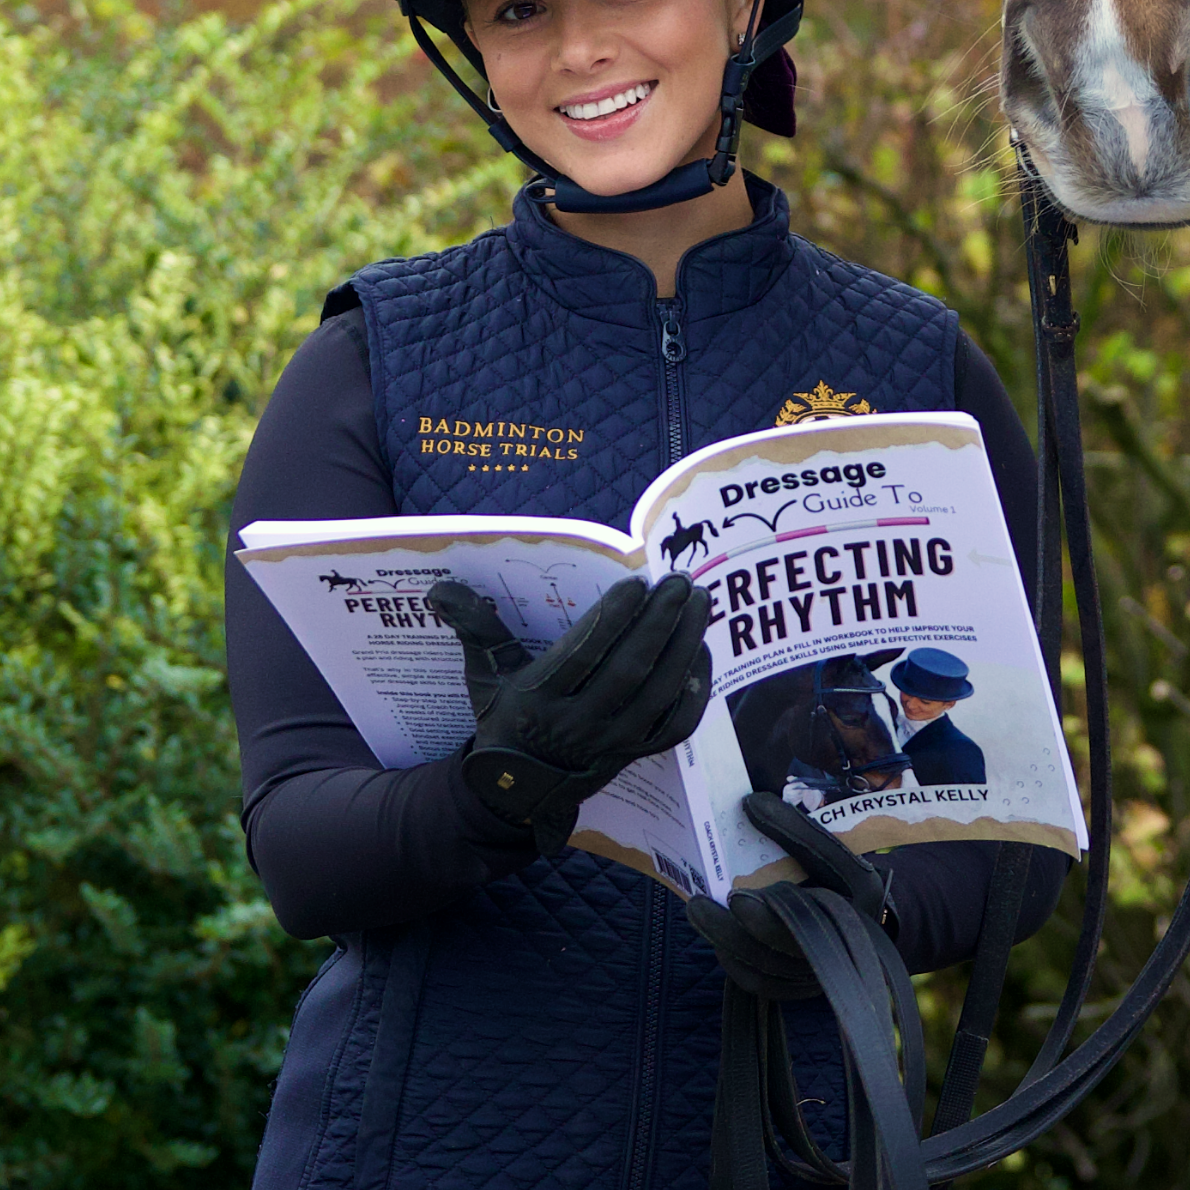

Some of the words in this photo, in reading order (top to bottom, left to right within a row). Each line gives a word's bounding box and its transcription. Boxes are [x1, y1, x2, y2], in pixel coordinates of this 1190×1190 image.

[418, 416, 585, 444] BADMINTON
[421, 439, 492, 457] HORSE
[499, 442, 579, 460] TRIALS
[719, 461, 887, 509] Dressage
[802, 488, 878, 514] Guide
[881, 484, 923, 505] To
[909, 504, 949, 514] Volume
[949, 505, 957, 514] 1
[375, 568, 452, 577] Dressage
[707, 537, 954, 628] ERFECTING
[379, 612, 442, 628] RHYT
[728, 579, 918, 658] RHYTHM
[712, 675, 723, 687] AY
[723, 656, 762, 679] TRAINING
[763, 648, 785, 661] PLAN
[794, 641, 811, 651] FILL
[812, 638, 822, 646] IN
[823, 629, 874, 643] WORKBOOK
[876, 627, 887, 635] TO
[888, 626, 910, 634] HELP
[718, 674, 745, 693] RIDING
[745, 657, 789, 679] DRESSAGE
[789, 648, 818, 662] SKILLS
[819, 642, 847, 654] USING
[848, 637, 879, 648] SIMPLE
[880, 636, 887, 644] &
[888, 634, 933, 643] EFFECTIVE
[933, 634, 978, 642] EXERCISES
[683, 740, 695, 768] HYTHM
[849, 790, 932, 815] KRYSTAL
[934, 789, 989, 802] KELLY
[703, 820, 715, 842] COACH
[709, 840, 720, 866] KRYSTAL
[715, 864, 724, 882] KELLY
